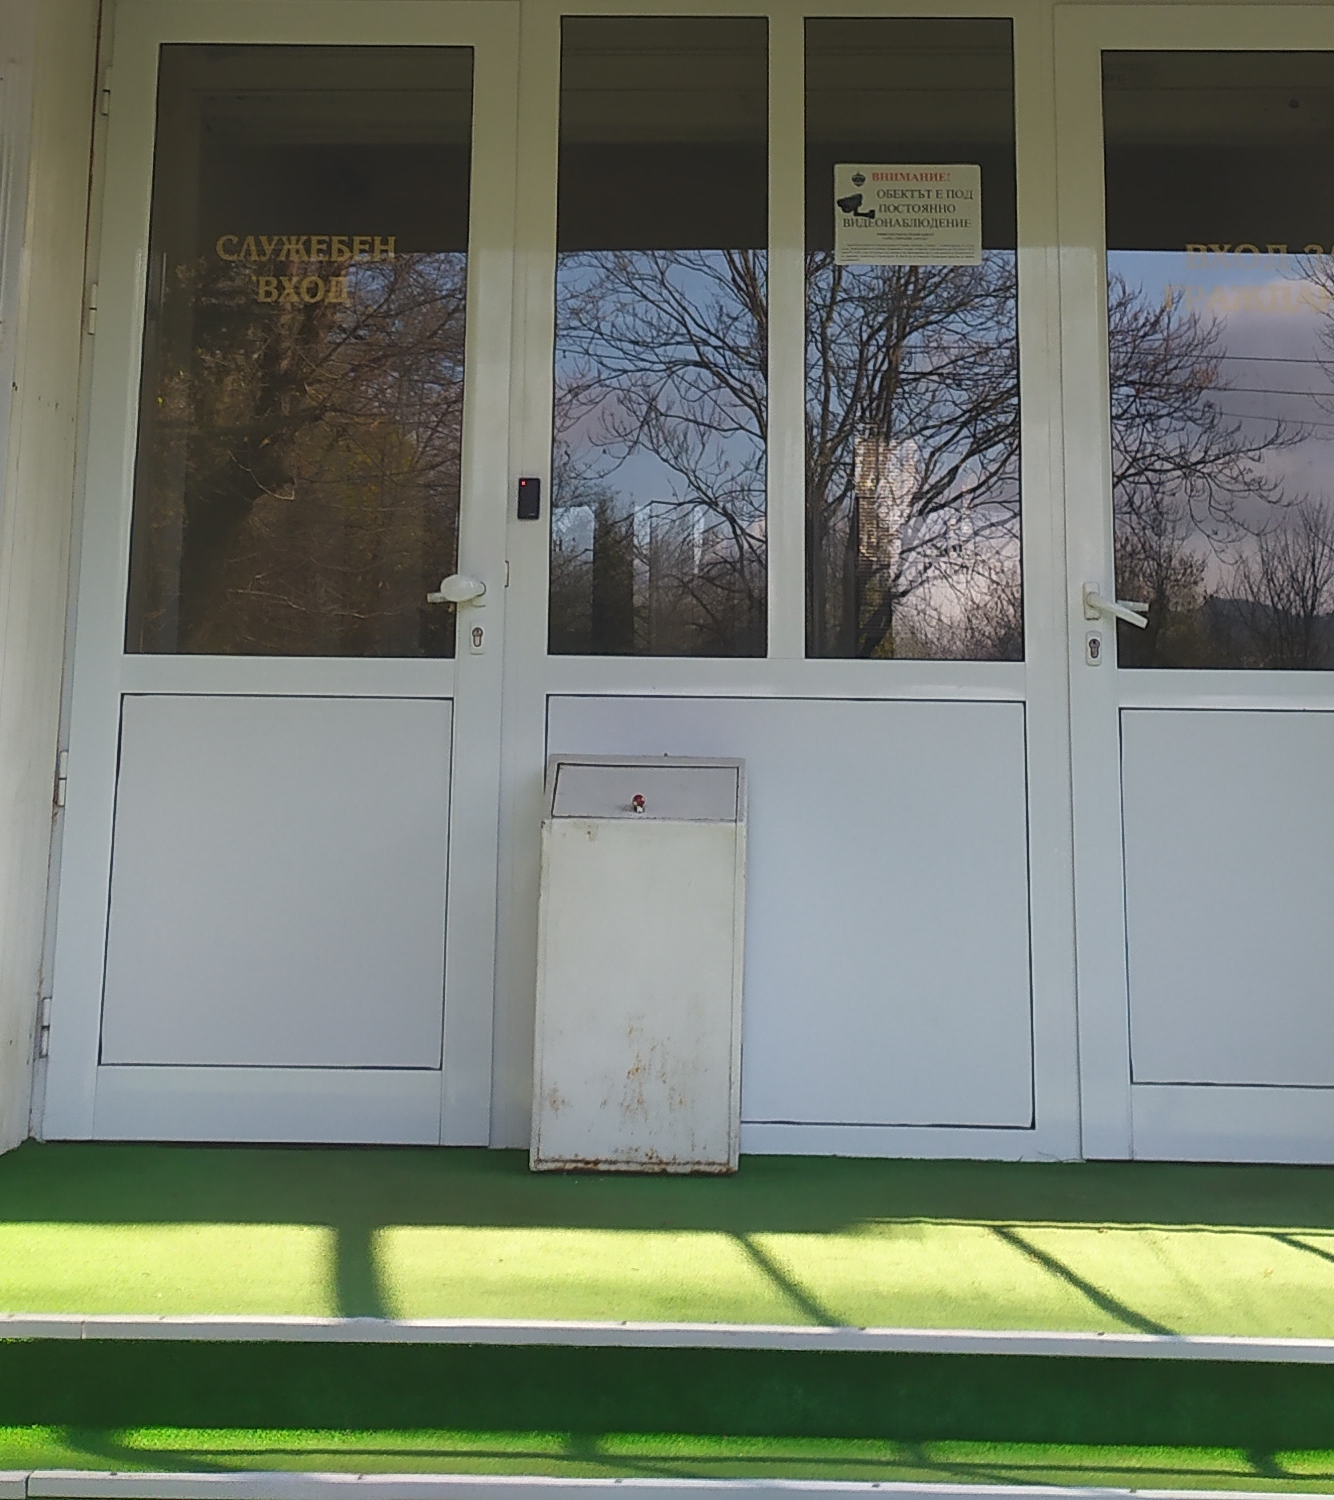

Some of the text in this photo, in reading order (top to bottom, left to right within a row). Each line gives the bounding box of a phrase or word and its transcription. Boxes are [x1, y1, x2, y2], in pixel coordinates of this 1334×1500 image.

[871, 172, 951, 182] ВНИМАНИЕ!
[877, 189, 973, 200] ОБЕКТЪТ Е ПОД
[879, 204, 956, 214] ПОСТОЯННО
[843, 218, 972, 228] ВИДЕОНАБЛЮДЕНИЕ
[216, 234, 397, 262] СЛУЖЕБЕН
[1186, 243, 1290, 270] ВХОД
[257, 276, 352, 304] ВХОД
